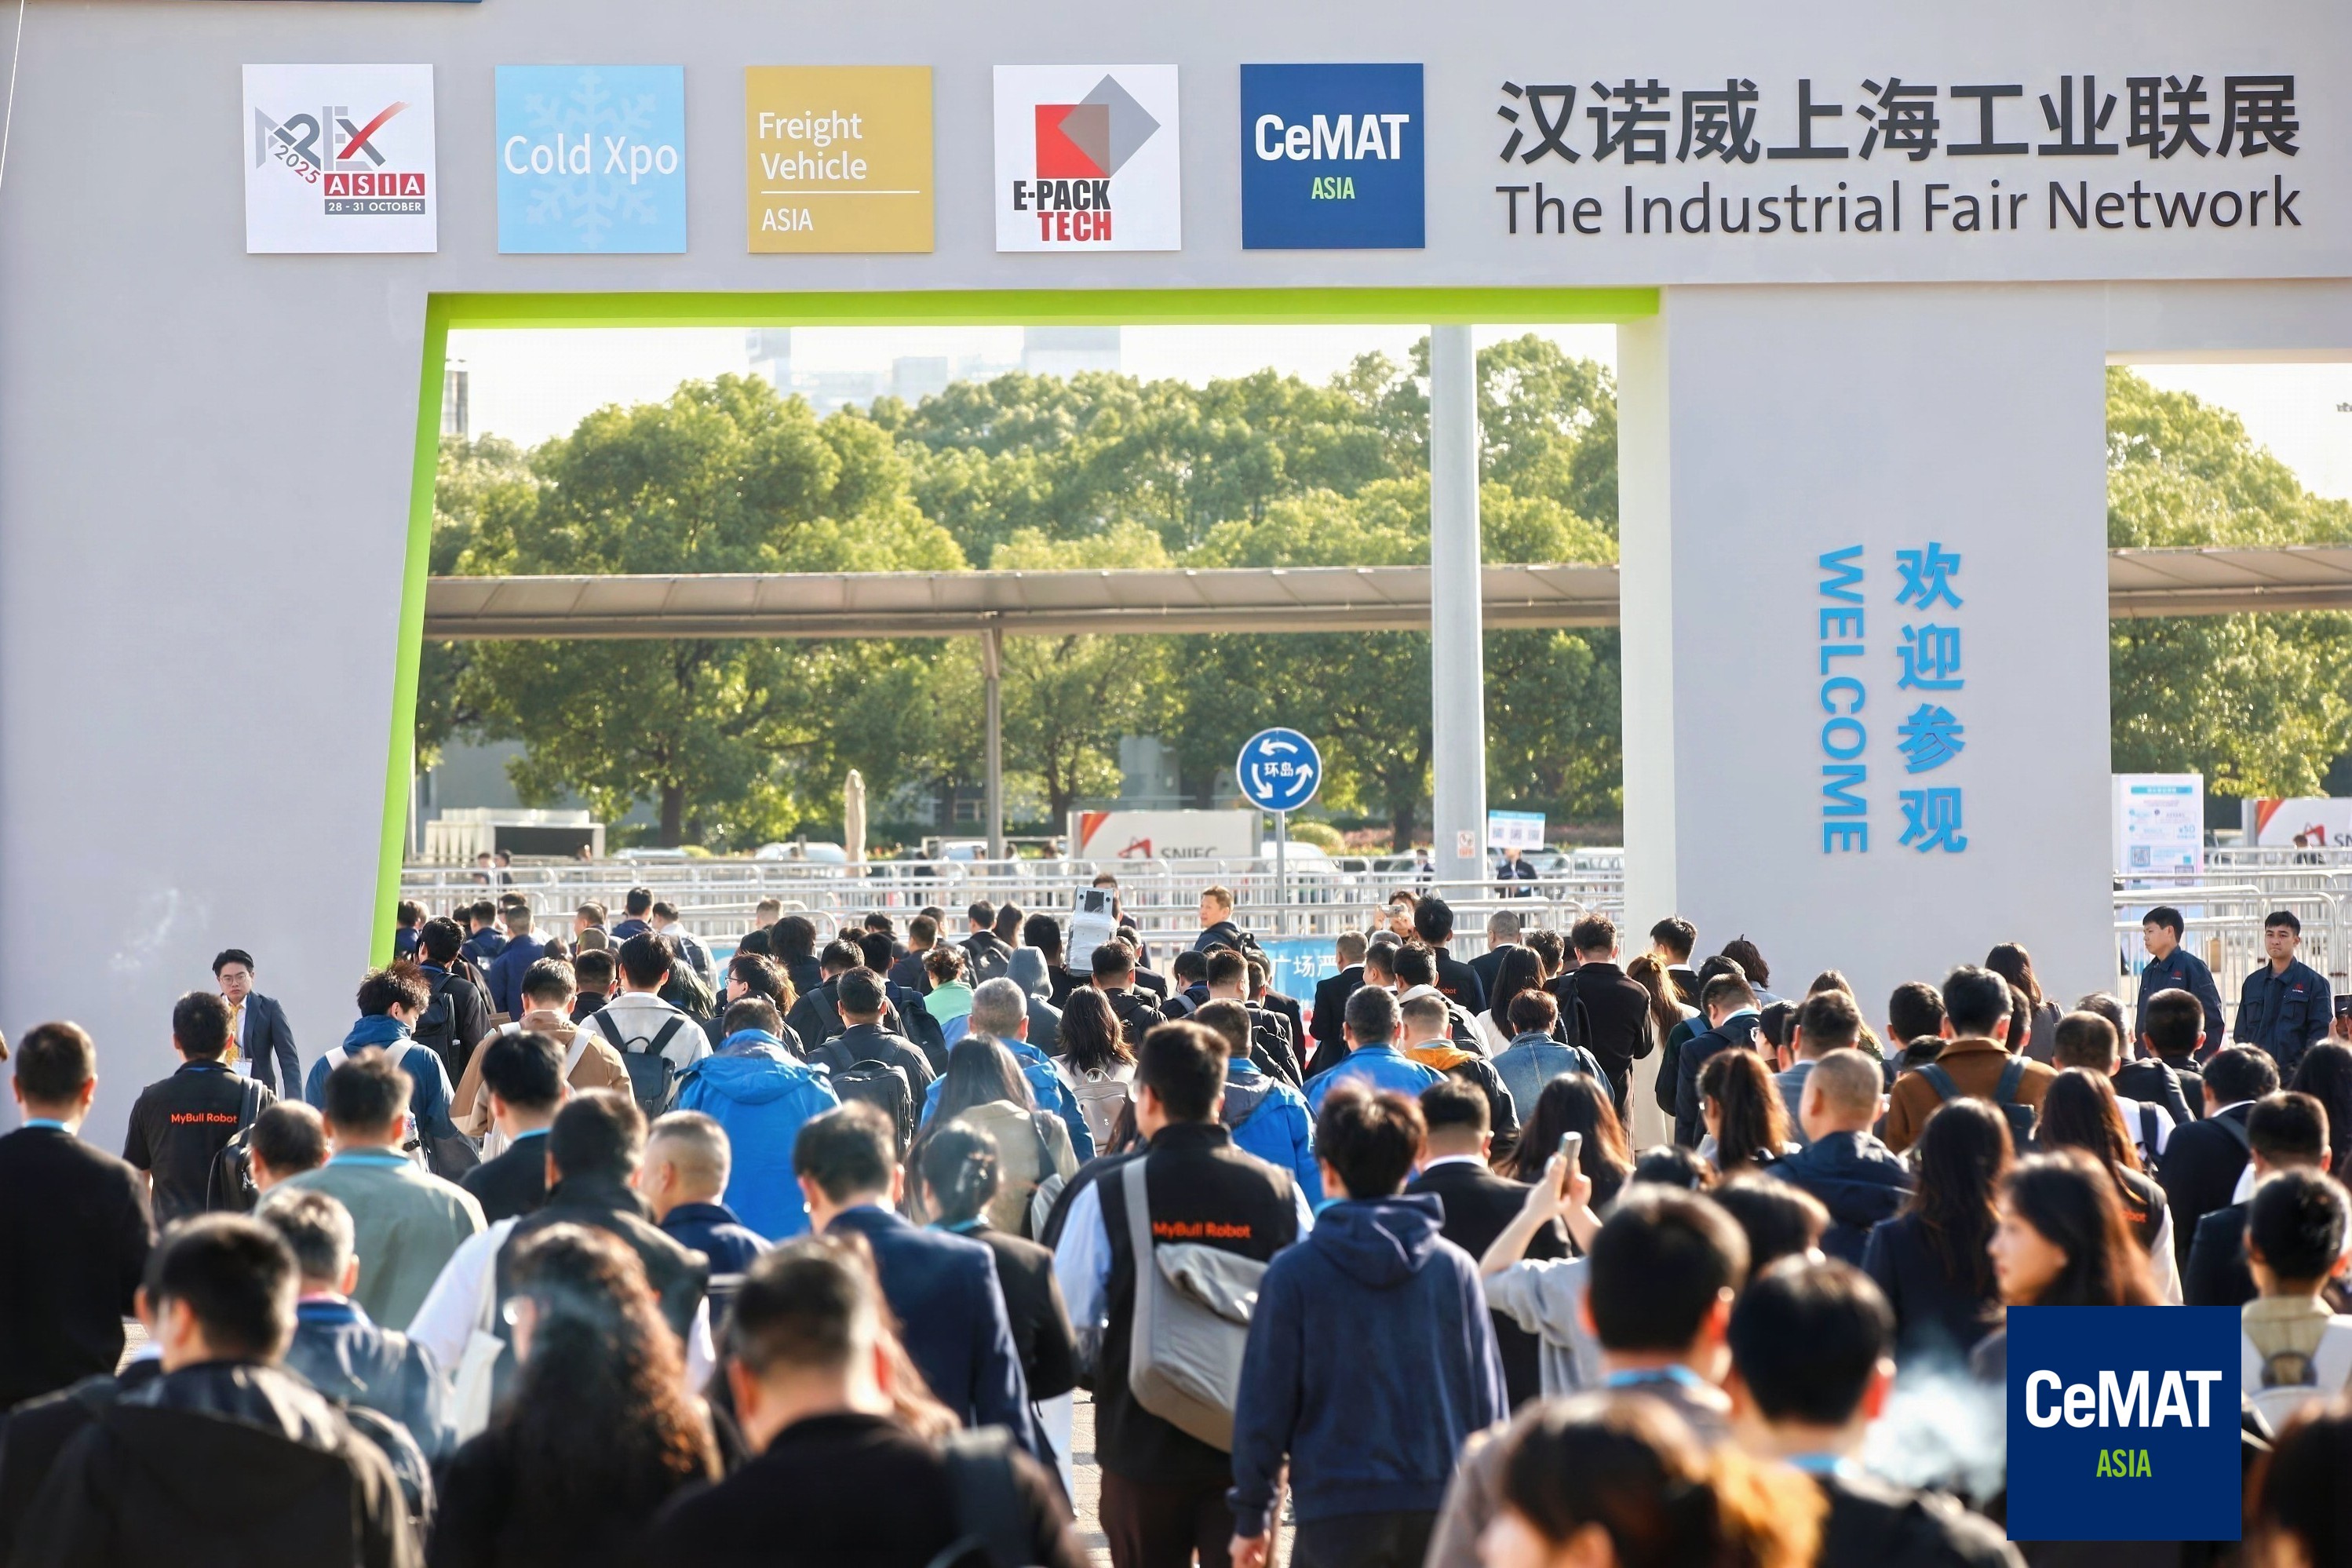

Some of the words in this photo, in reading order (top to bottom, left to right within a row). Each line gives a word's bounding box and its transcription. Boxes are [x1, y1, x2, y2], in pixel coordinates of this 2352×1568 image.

[759, 111, 862, 148] Freight
[1497, 74, 2301, 165] 汉诺威上海工业联展
[1255, 114, 1409, 161] CeMAT
[274, 144, 320, 184] 2025
[505, 133, 591, 174] Cold
[603, 136, 678, 184] Xpo
[760, 150, 867, 181] Vehicle
[328, 175, 421, 195] ASIA
[1013, 180, 1111, 211] E-PACK
[1311, 177, 1355, 200] ASIA
[328, 202, 342, 212] 28
[353, 202, 364, 212] 31
[369, 202, 421, 212] OCTOBER
[761, 208, 814, 232] ASIA
[1496, 182, 1603, 235] The
[1625, 181, 1901, 234] Industrial
[1925, 180, 2028, 232] Fair
[2049, 174, 2303, 229] Network
[1037, 210, 1111, 242] TECH
[1818, 544, 1868, 853] WELCOME
[1894, 542, 1968, 853] 欢迎参观
[1264, 761, 1294, 777] 环岛
[171, 1113, 204, 1124] MyBull
[206, 1113, 237, 1123] Robot
[1153, 1221, 1203, 1239] MyBull
[1205, 1221, 1252, 1238] Robot
